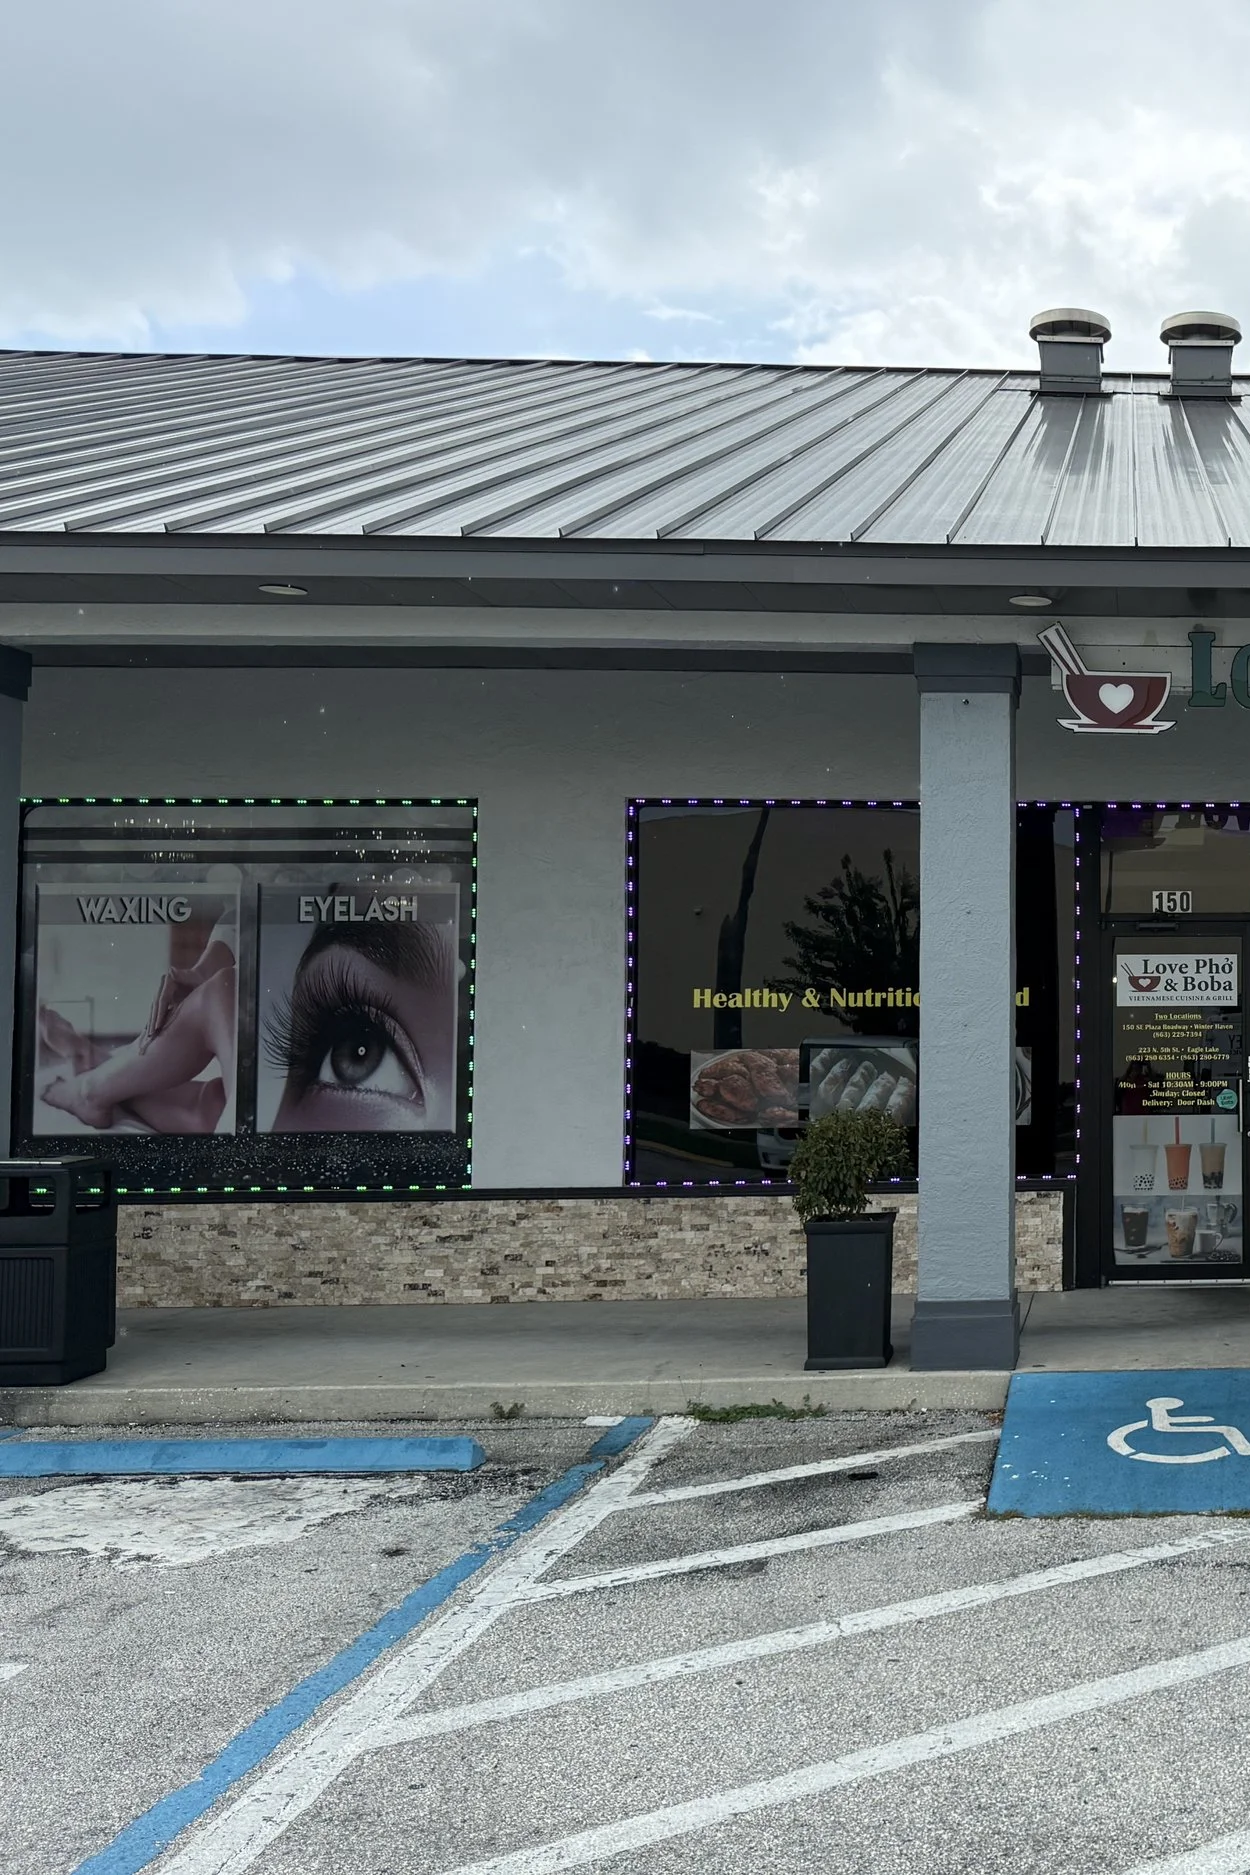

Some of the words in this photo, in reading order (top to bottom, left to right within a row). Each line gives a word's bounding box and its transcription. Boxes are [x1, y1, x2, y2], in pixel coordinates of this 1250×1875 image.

[1155, 892, 1191, 913] 150
[77, 896, 192, 924] WAXING
[299, 896, 418, 923] EYELASH
[1142, 959, 1189, 974] Love
[1164, 978, 1178, 992] &
[1183, 976, 1234, 992] Boba
[693, 987, 793, 1012] Healthy
[801, 988, 820, 1008] &
[1169, 1012, 1202, 1020] Locations
[1187, 1046, 1203, 1054] Eagle
[1165, 1072, 1192, 1080] HOURS
[1162, 1080, 1194, 1088] 10:30AM
[1200, 1080, 1228, 1088] 9:00PM
[1181, 1089, 1206, 1097] Closed
[1142, 1099, 1173, 1108] Delivery:
[1177, 1098, 1195, 1106] Door
[1196, 1098, 1215, 1106] Dash
